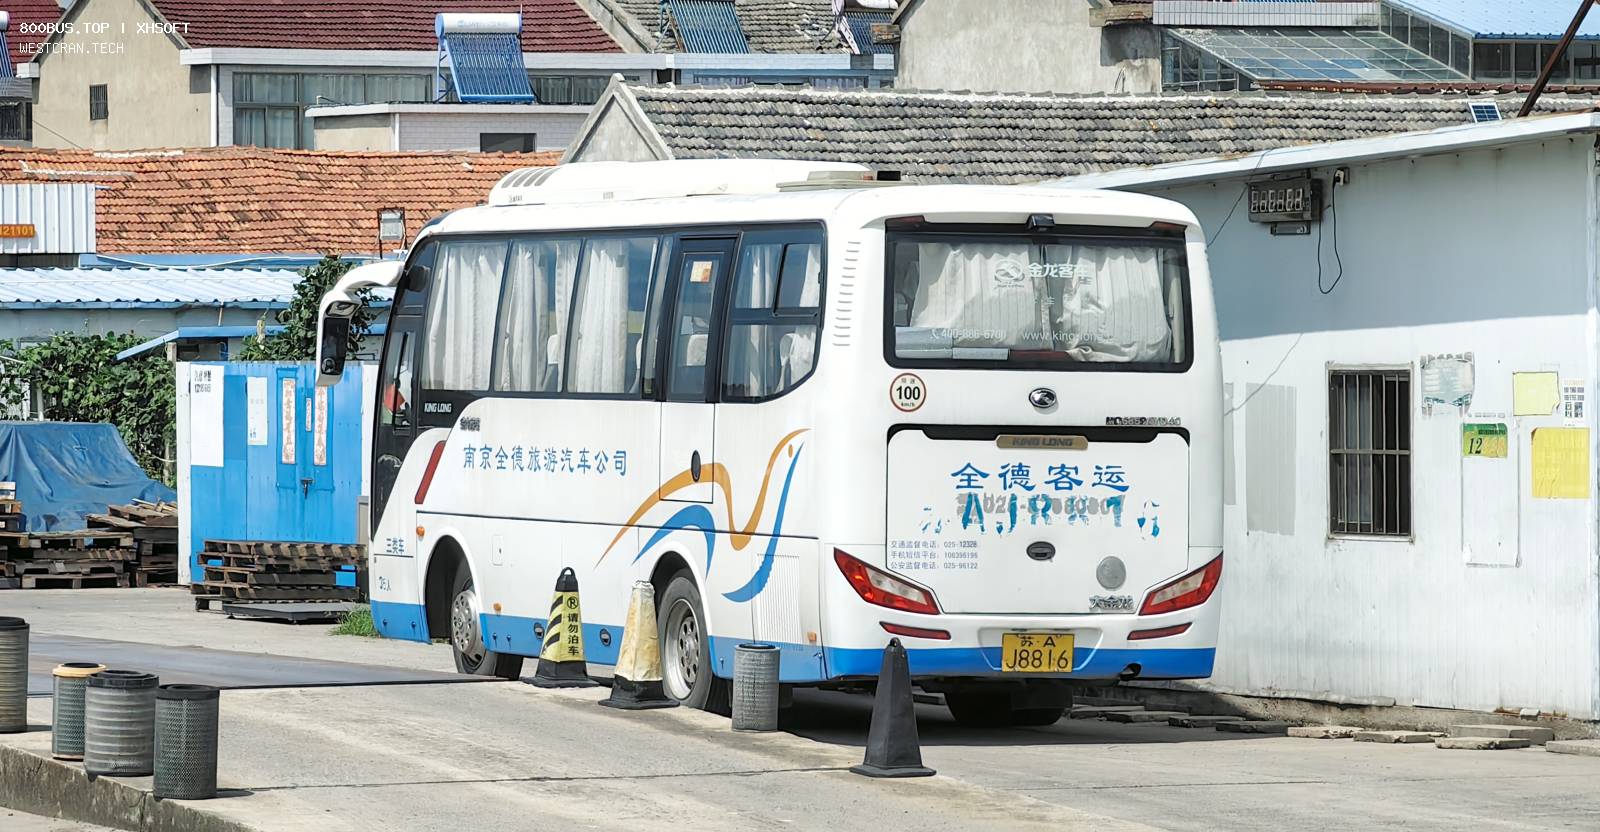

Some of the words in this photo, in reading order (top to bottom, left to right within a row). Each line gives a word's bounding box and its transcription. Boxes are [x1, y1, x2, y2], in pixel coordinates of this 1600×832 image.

[896, 385, 921, 401] 100
[424, 403, 438, 413] KING
[438, 403, 452, 413] LONG
[1012, 437, 1040, 447] KING
[1042, 437, 1074, 447] LONG
[1468, 437, 1483, 455] 12
[463, 443, 628, 477] 南京全德旅游汽车公司
[950, 462, 1131, 493] 全德客运
[567, 613, 580, 656] 请勿泊车
[1005, 649, 1069, 669] J8816
